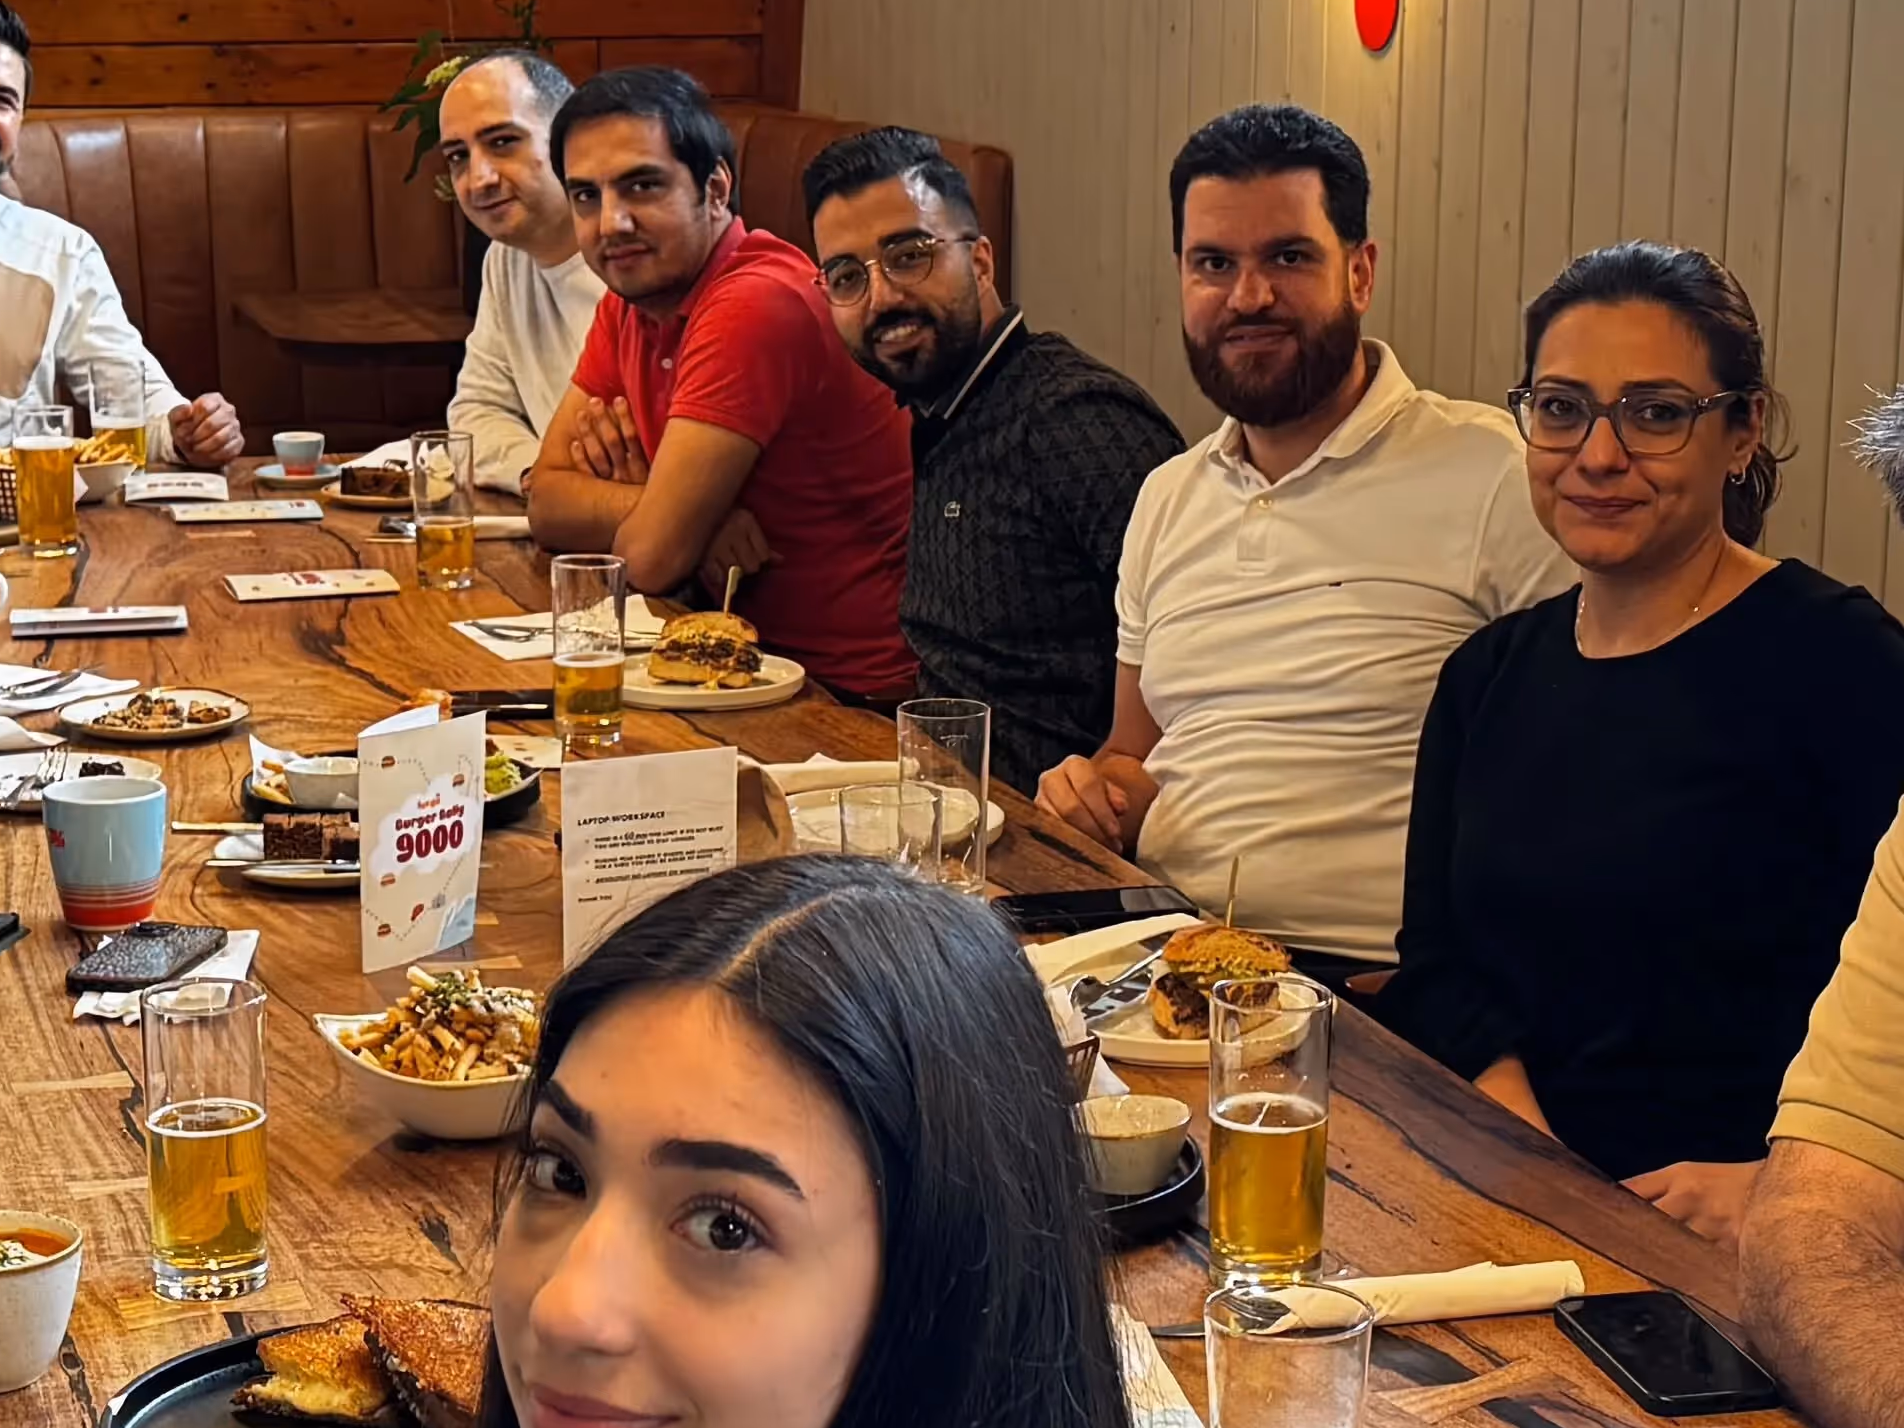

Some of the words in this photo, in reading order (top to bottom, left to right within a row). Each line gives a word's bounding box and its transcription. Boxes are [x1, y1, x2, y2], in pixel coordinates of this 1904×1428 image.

[395, 813, 437, 831] Burger
[577, 816, 610, 826] LAPTOP
[396, 819, 464, 863] 9000
